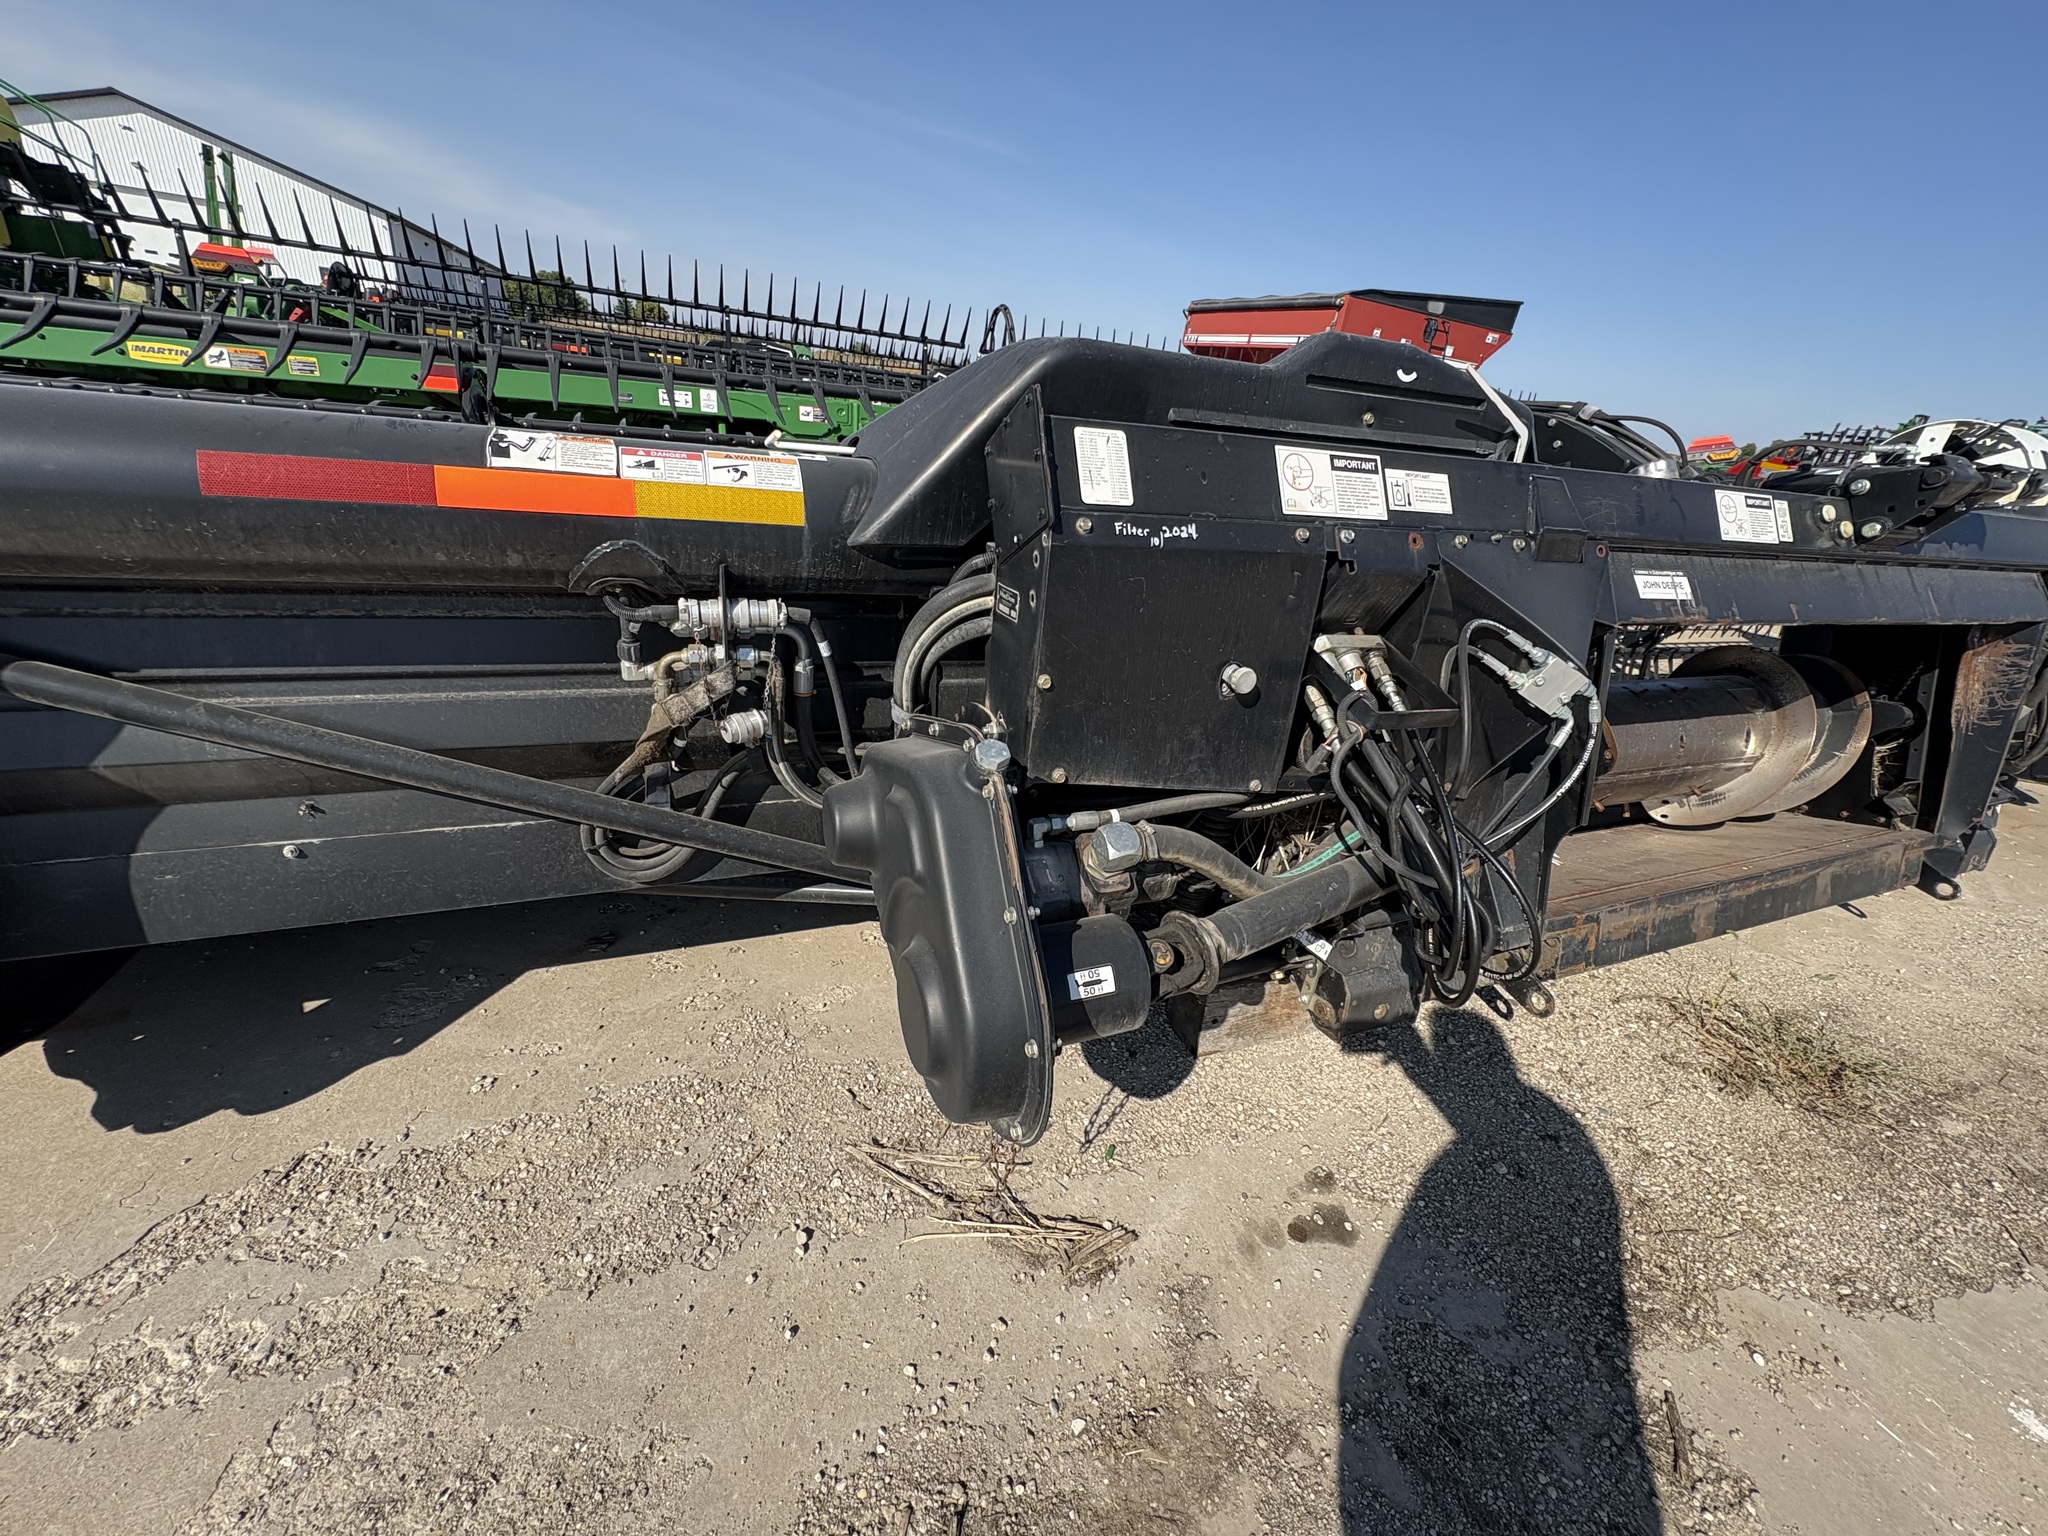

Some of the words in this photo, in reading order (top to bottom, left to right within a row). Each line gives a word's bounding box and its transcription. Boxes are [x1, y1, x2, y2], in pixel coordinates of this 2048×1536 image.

[134, 344, 189, 357] MARTIN
[650, 451, 687, 459] DANGER
[734, 454, 781, 463] WARNING
[1333, 458, 1376, 471] IMPORTANT
[1114, 522, 1150, 536] Filter
[1642, 580, 1661, 589] JOHN
[1661, 581, 1684, 590] DEERE
[1088, 969, 1100, 979] 50
[1084, 987, 1096, 997] 50
